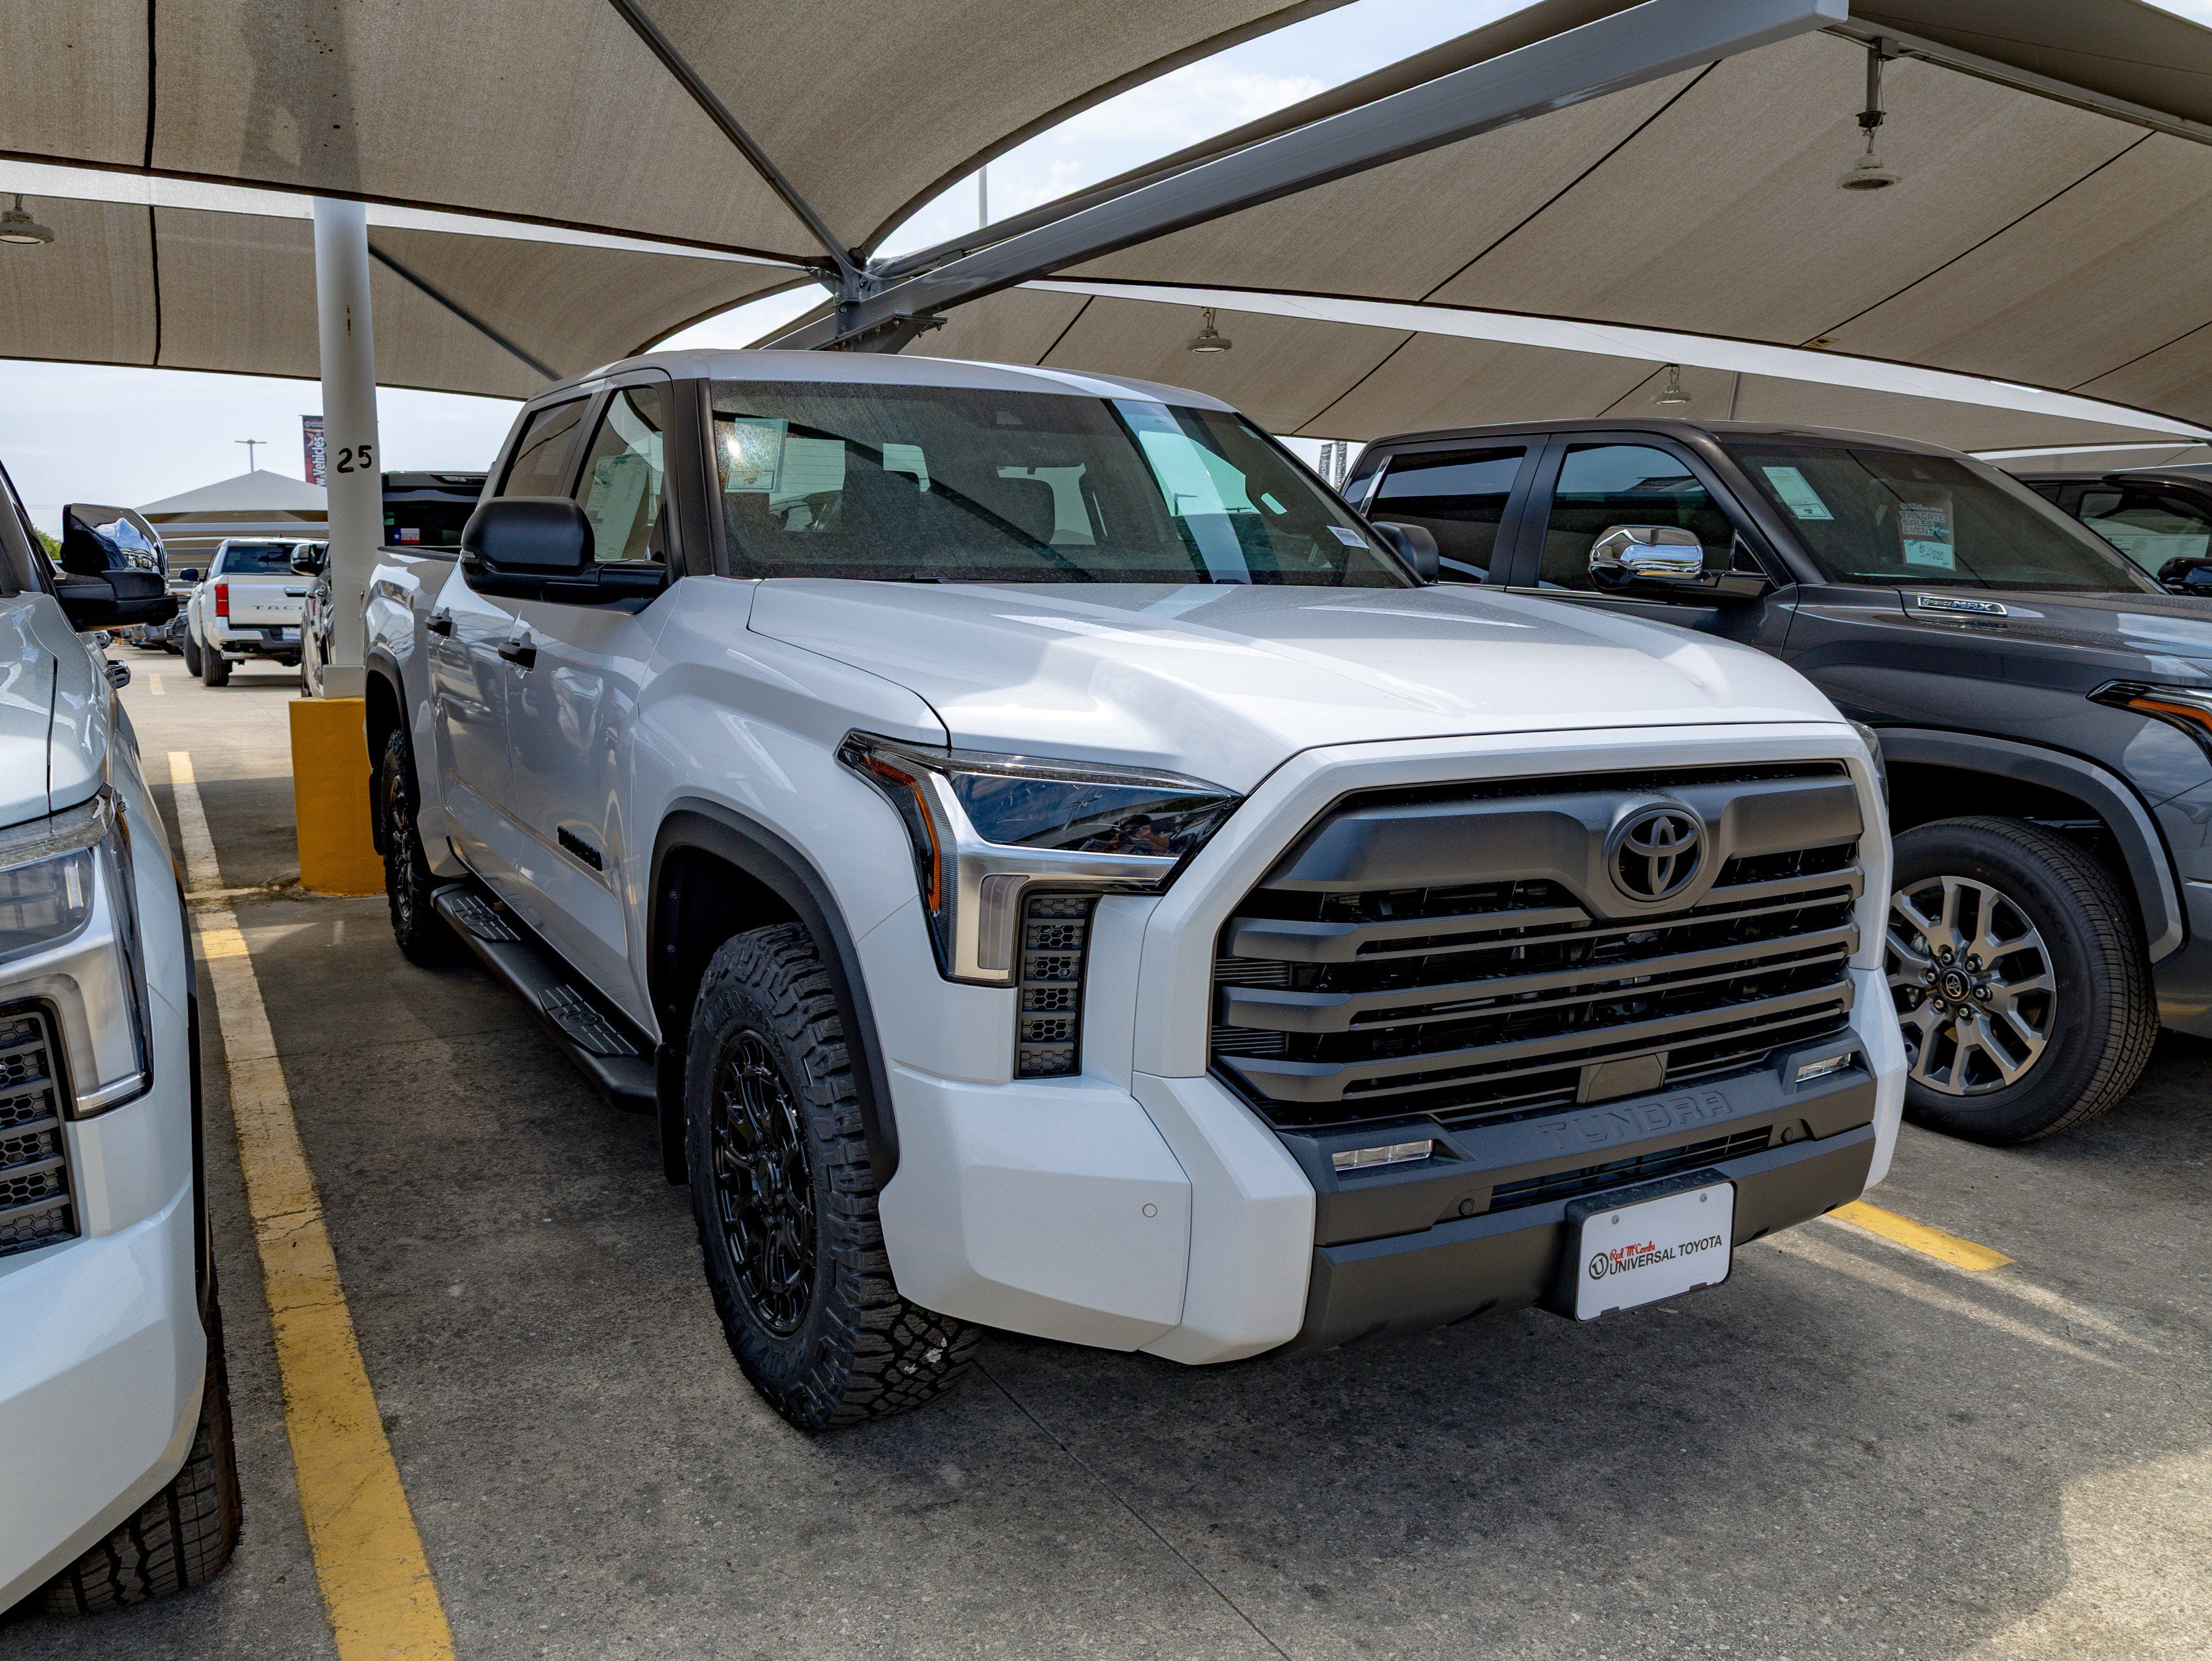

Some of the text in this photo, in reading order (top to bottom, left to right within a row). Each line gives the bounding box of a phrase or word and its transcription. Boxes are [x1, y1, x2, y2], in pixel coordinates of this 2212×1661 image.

[312, 436, 325, 476] Vehicles
[337, 445, 372, 474] 25
[1901, 512, 1945, 521] TAILGATE
[1952, 600, 1993, 611] MAX
[1535, 1091, 1733, 1149] TUNDRA
[1609, 1240, 1655, 1263] Red McCombs
[1609, 1248, 1676, 1275] UNIVERSAL
[1679, 1235, 1722, 1257] TOYOTA
